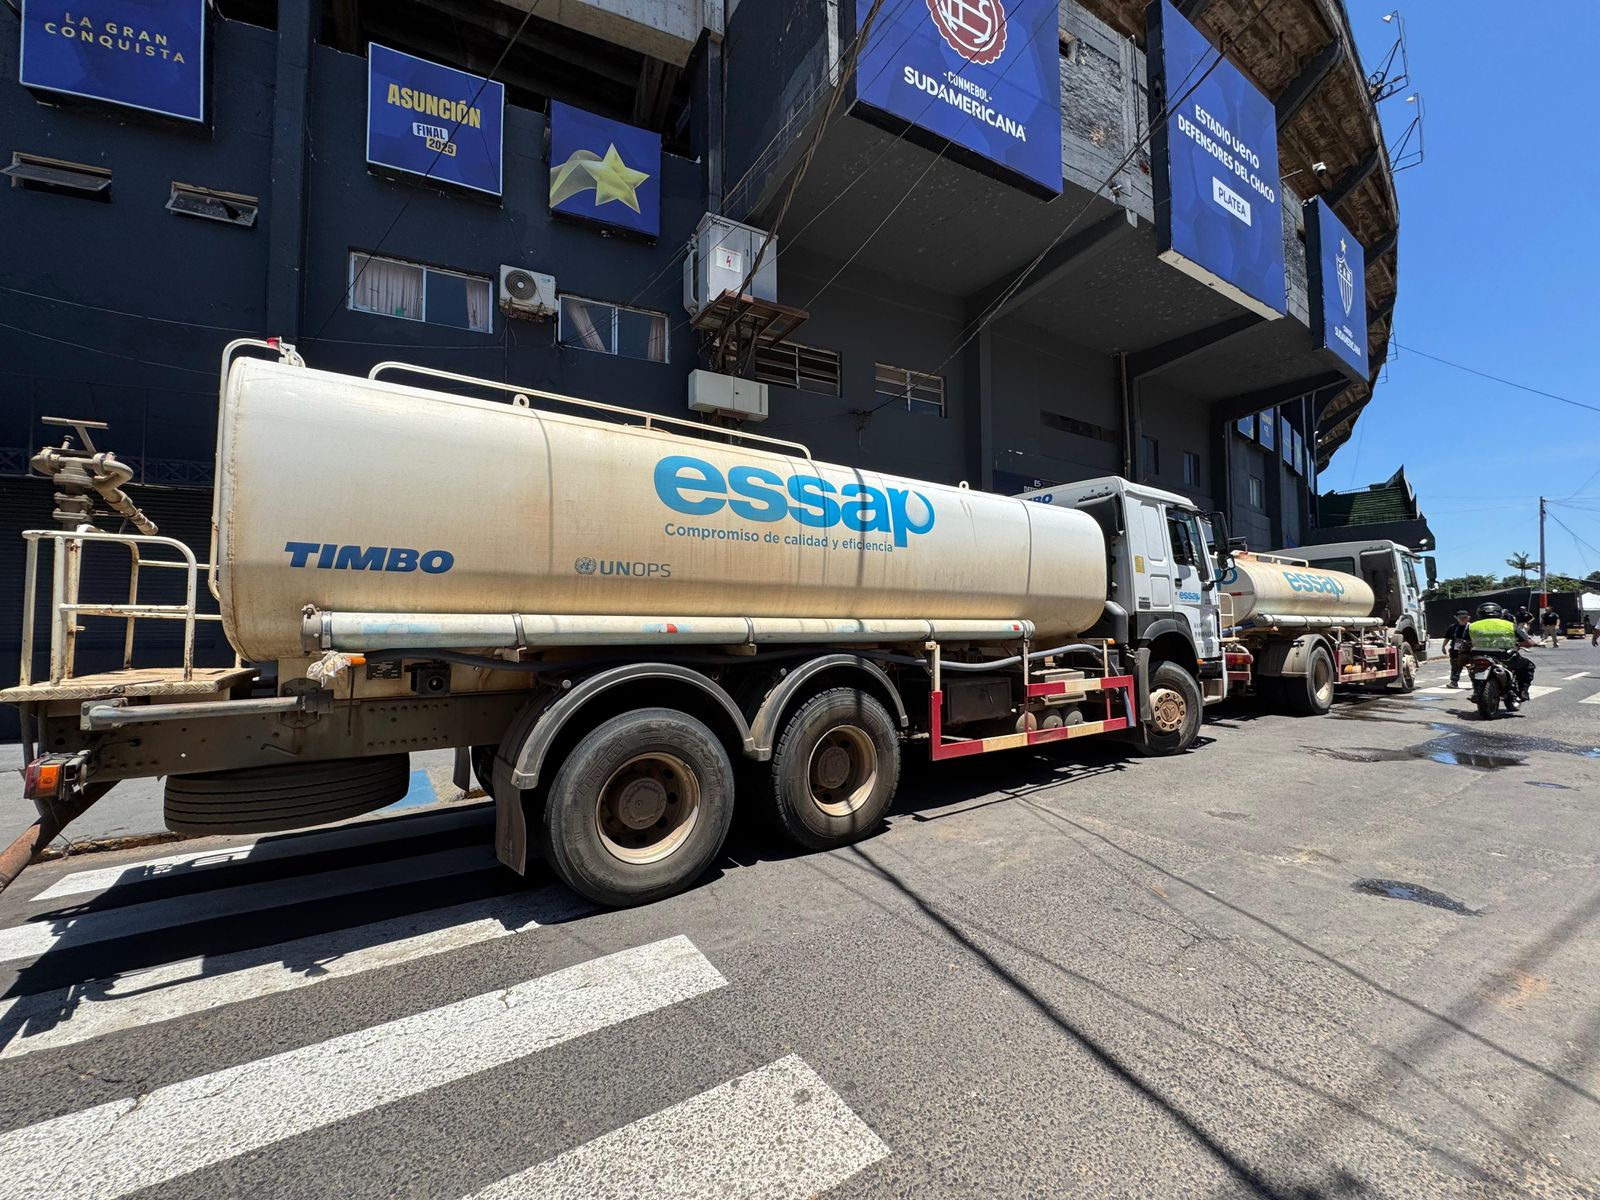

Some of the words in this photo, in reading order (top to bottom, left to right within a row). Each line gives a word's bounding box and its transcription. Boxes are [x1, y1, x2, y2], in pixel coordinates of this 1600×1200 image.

[44, 22, 186, 64] CONQUISTA
[65, 12, 92, 29] LA
[105, 22, 168, 46] GRAN
[387, 83, 481, 129] ASUNCIÓN
[904, 65, 1027, 142] SUDAMERICANA
[416, 124, 446, 140] FINAL
[1195, 103, 1231, 146] ESTADIO
[428, 137, 454, 155] 2025
[1178, 113, 1234, 170] DEFENSORES
[1234, 160, 1250, 184] DEL
[1250, 173, 1275, 204] CHACO
[1218, 185, 1247, 217] PLATEA
[653, 455, 936, 548] essap
[664, 522, 759, 543] Compromiso
[764, 531, 780, 545] de
[784, 533, 828, 548] calidad
[832, 540, 839, 551] y
[842, 539, 893, 553] eficiencia
[284, 541, 455, 575] TIMBO
[600, 559, 672, 578] UNOPS
[1178, 591, 1201, 602] essap
[1282, 571, 1345, 602] essap
